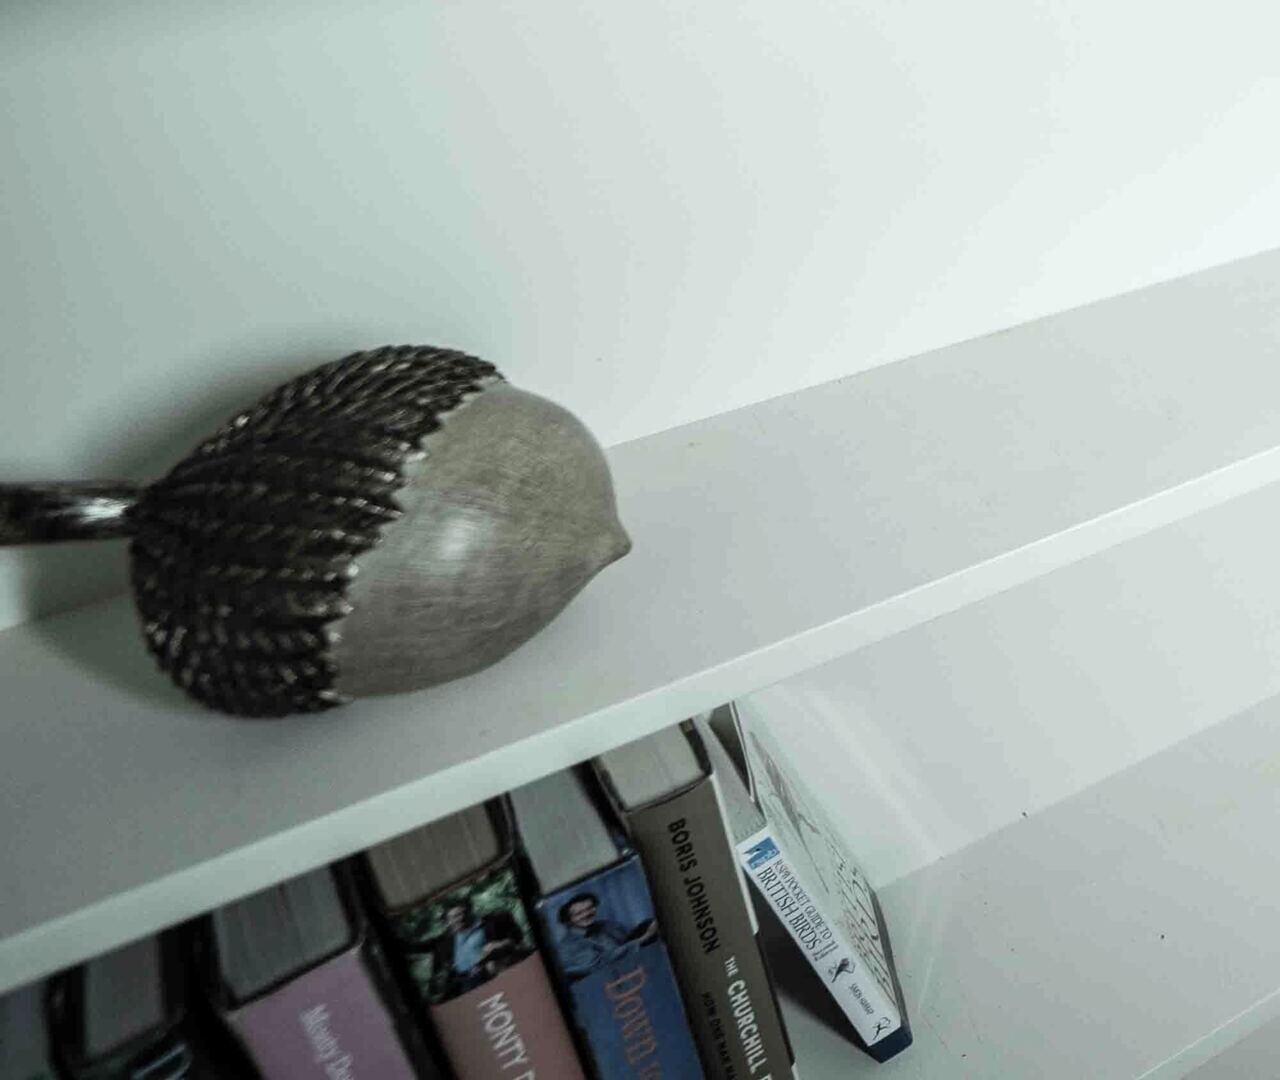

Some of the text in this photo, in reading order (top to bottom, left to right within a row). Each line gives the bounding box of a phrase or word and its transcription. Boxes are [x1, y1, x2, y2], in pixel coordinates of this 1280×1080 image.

[669, 817, 720, 955] BORIS JOHNSON
[757, 866, 822, 951] BRITISH BIRDS
[476, 991, 530, 1070] MONTY
[724, 955, 768, 1075] THE CHURCHILL
